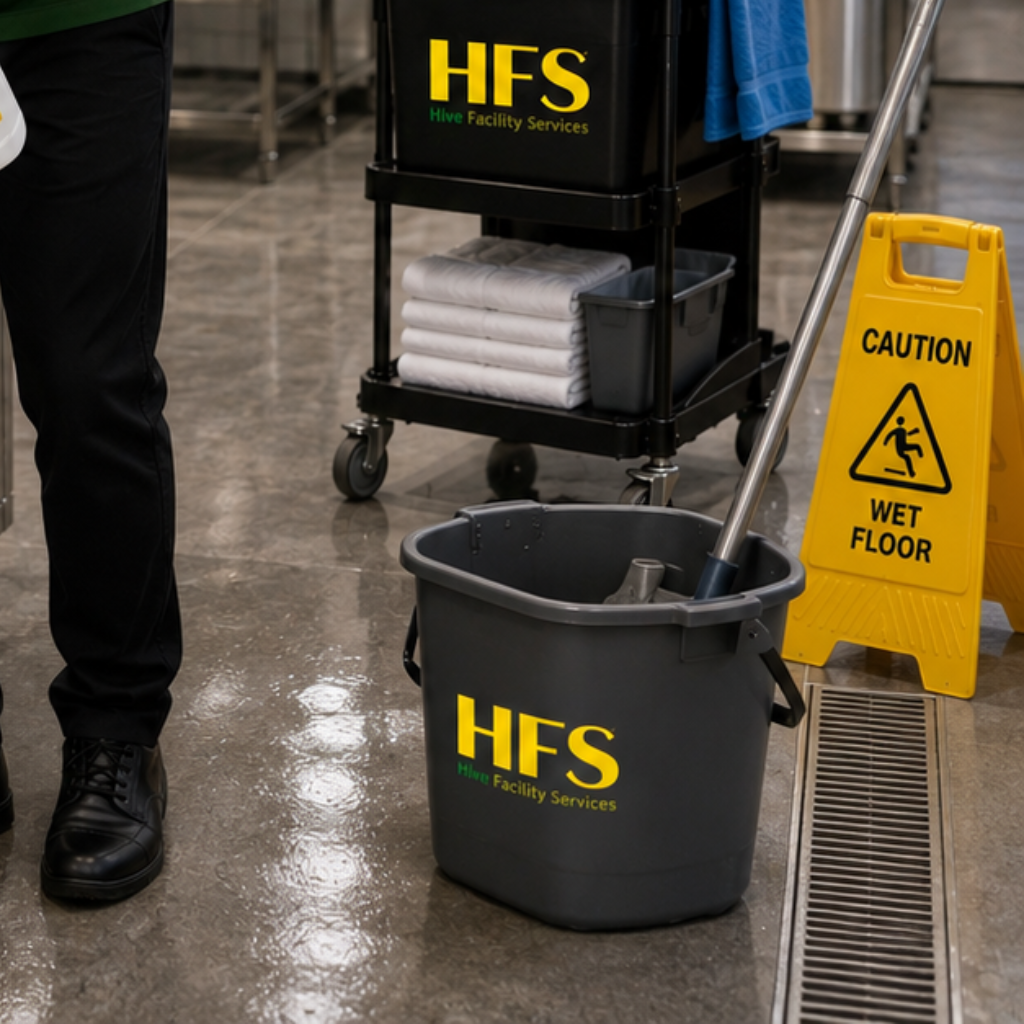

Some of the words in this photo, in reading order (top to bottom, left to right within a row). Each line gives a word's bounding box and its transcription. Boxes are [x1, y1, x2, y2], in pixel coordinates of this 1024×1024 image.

[429, 38, 590, 113] HFS
[429, 107, 463, 124] Hive
[467, 110, 523, 133] Facility
[527, 115, 589, 135] Services
[861, 327, 973, 368] CAUTION
[870, 498, 923, 529] WET
[850, 526, 932, 564] FLOOR
[457, 693, 620, 791] HFS
[493, 774, 546, 804] Facility
[550, 790, 617, 812] Services
